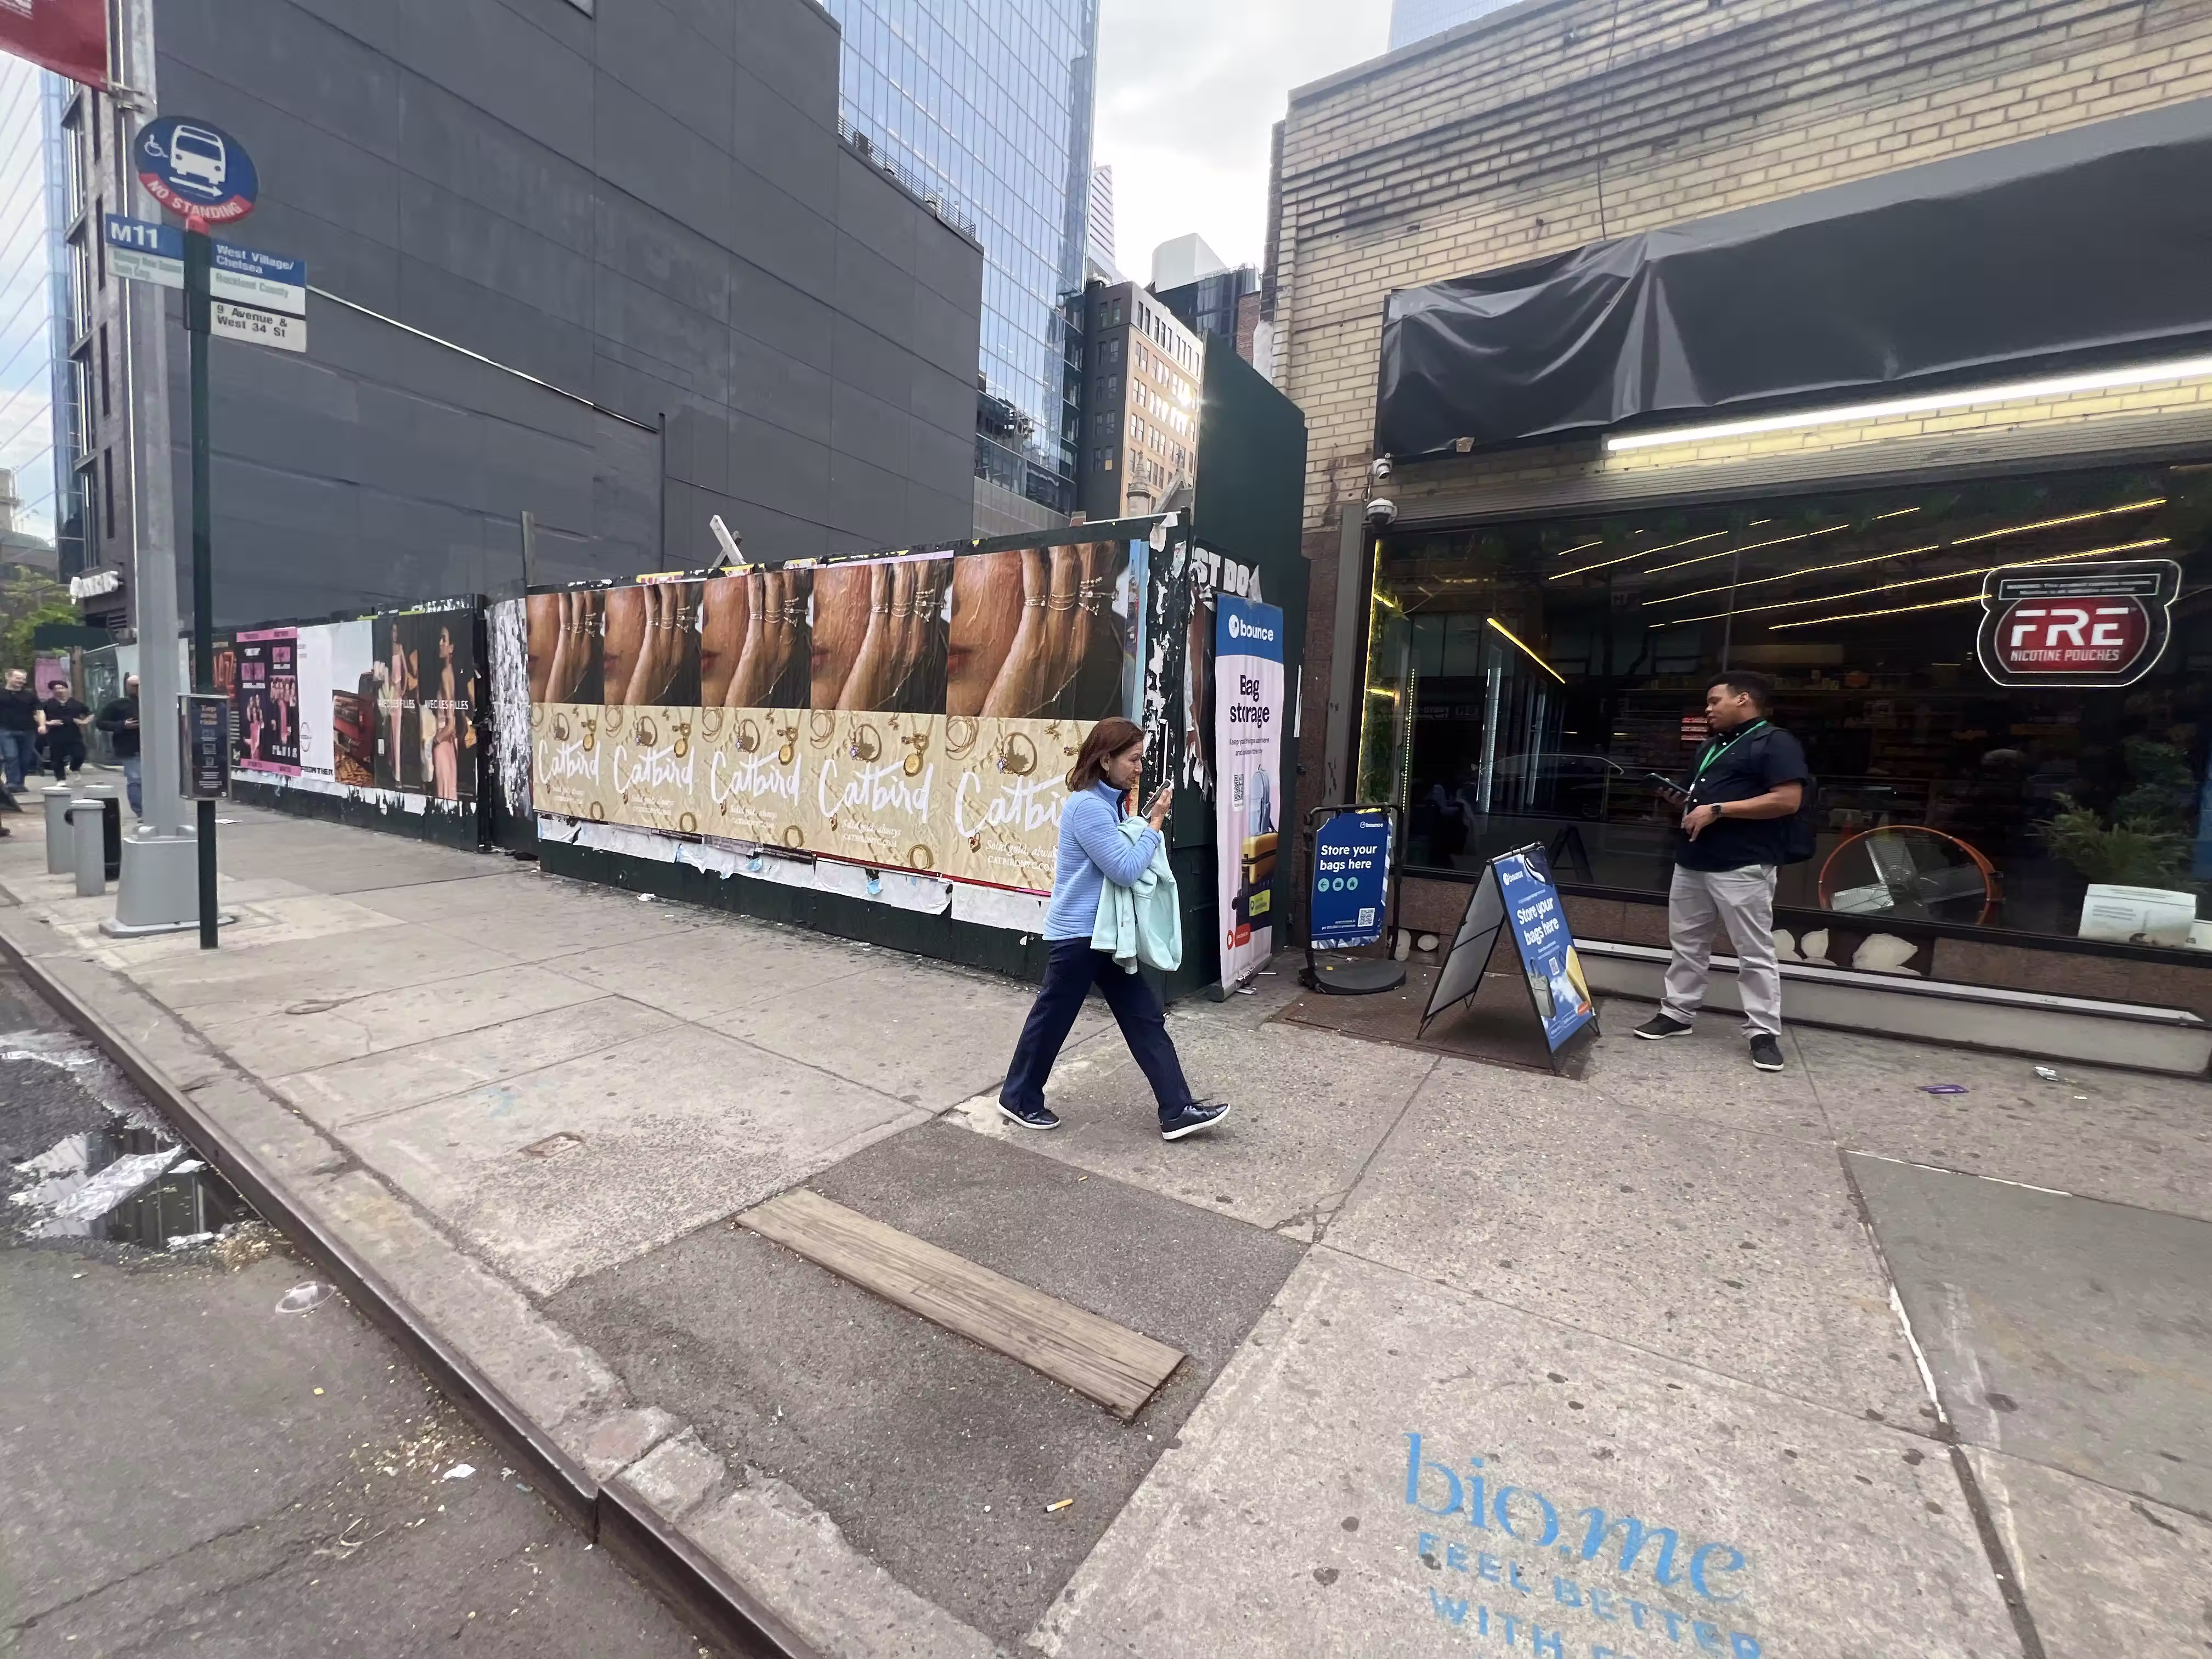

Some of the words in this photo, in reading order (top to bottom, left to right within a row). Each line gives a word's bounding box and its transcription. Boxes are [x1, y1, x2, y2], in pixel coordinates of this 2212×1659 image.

[147, 180, 168, 200] NO
[172, 195, 243, 220] STANDING
[110, 222, 158, 250] M11
[216, 244, 246, 259] West
[216, 255, 263, 274] Chelsea
[217, 305, 224, 314] 9
[232, 308, 273, 325] Avenue
[279, 318, 288, 328] &
[217, 315, 246, 329] West
[252, 323, 266, 333] 34
[274, 327, 285, 337] St
[1240, 619, 1274, 642] bounce
[2010, 607, 2130, 647] FRE
[2010, 649, 2063, 662] NICOTINE
[2064, 648, 2121, 662] POUCHES
[1239, 674, 1260, 702] Bag
[425, 699, 438, 709] AVEC
[538, 739, 601, 786] Catbird
[614, 744, 695, 795] Catbird
[710, 750, 802, 806] Catbird
[818, 758, 933, 825] Catbird
[954, 771, 1067, 839] Catbi
[986, 839, 1007, 853] Solid
[1321, 845, 1350, 856] Store
[1352, 845, 1378, 857] your
[1319, 860, 1345, 873] bags
[1348, 859, 1372, 870] here
[1517, 906, 1538, 925] Store
[1536, 897, 1554, 919] your
[1523, 926, 1544, 946] bags
[1541, 917, 1559, 935] here
[1418, 1531, 1532, 1598] FEEL
[1428, 1587, 1564, 1659] WITH
